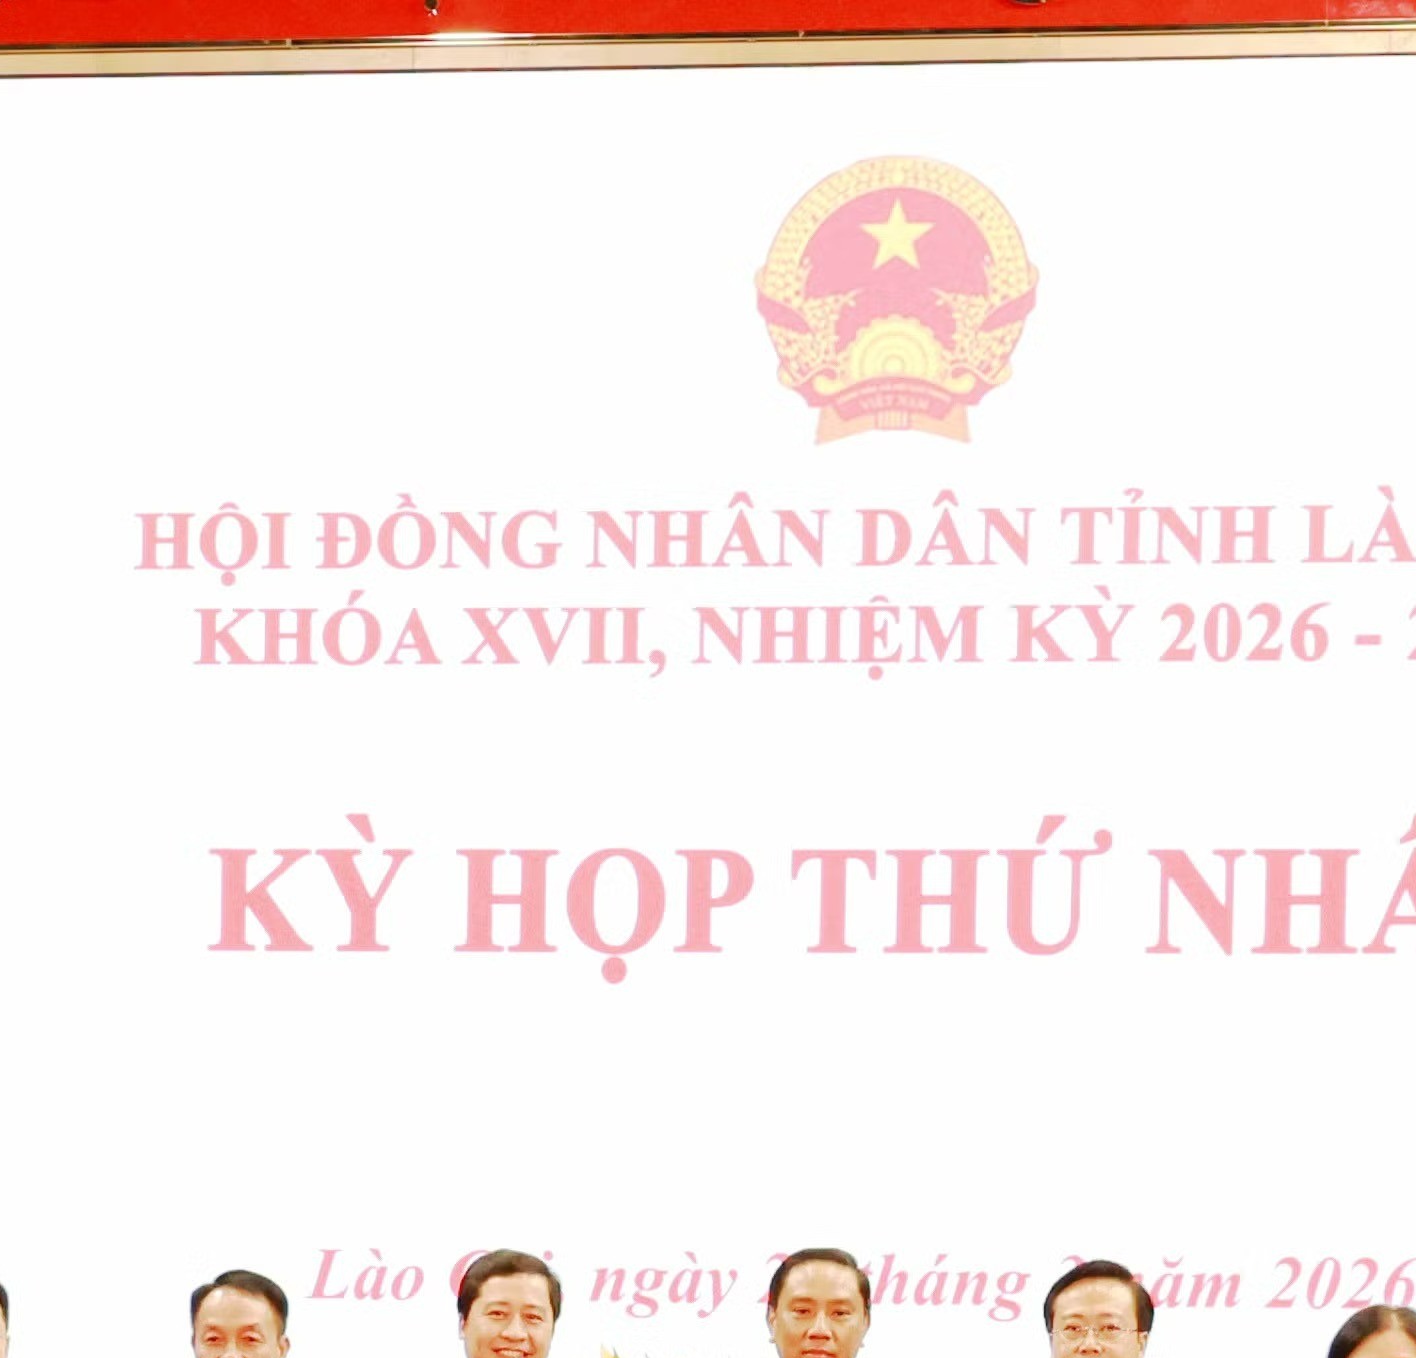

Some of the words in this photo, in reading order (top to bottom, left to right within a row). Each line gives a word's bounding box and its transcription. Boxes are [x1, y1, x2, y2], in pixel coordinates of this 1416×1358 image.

[134, 501, 290, 584] HỘI
[316, 493, 561, 570] ĐỒNG
[588, 490, 826, 569] NHÂN
[856, 490, 1034, 567] DÂN
[1059, 488, 1273, 565] TỈNH
[194, 589, 442, 668] KHÓA
[462, 606, 666, 679] XVII,
[693, 594, 983, 682] NHIỆM
[1011, 583, 1134, 663] KỲ
[1157, 602, 1330, 664] 2026
[1354, 634, 1382, 646] -
[206, 812, 416, 954] KỲ
[454, 845, 756, 986] HỌP
[789, 813, 1115, 958] THỨ
[306, 1248, 425, 1301] Lào
[589, 1251, 738, 1320] ngày
[1132, 1254, 1241, 1309] ăm
